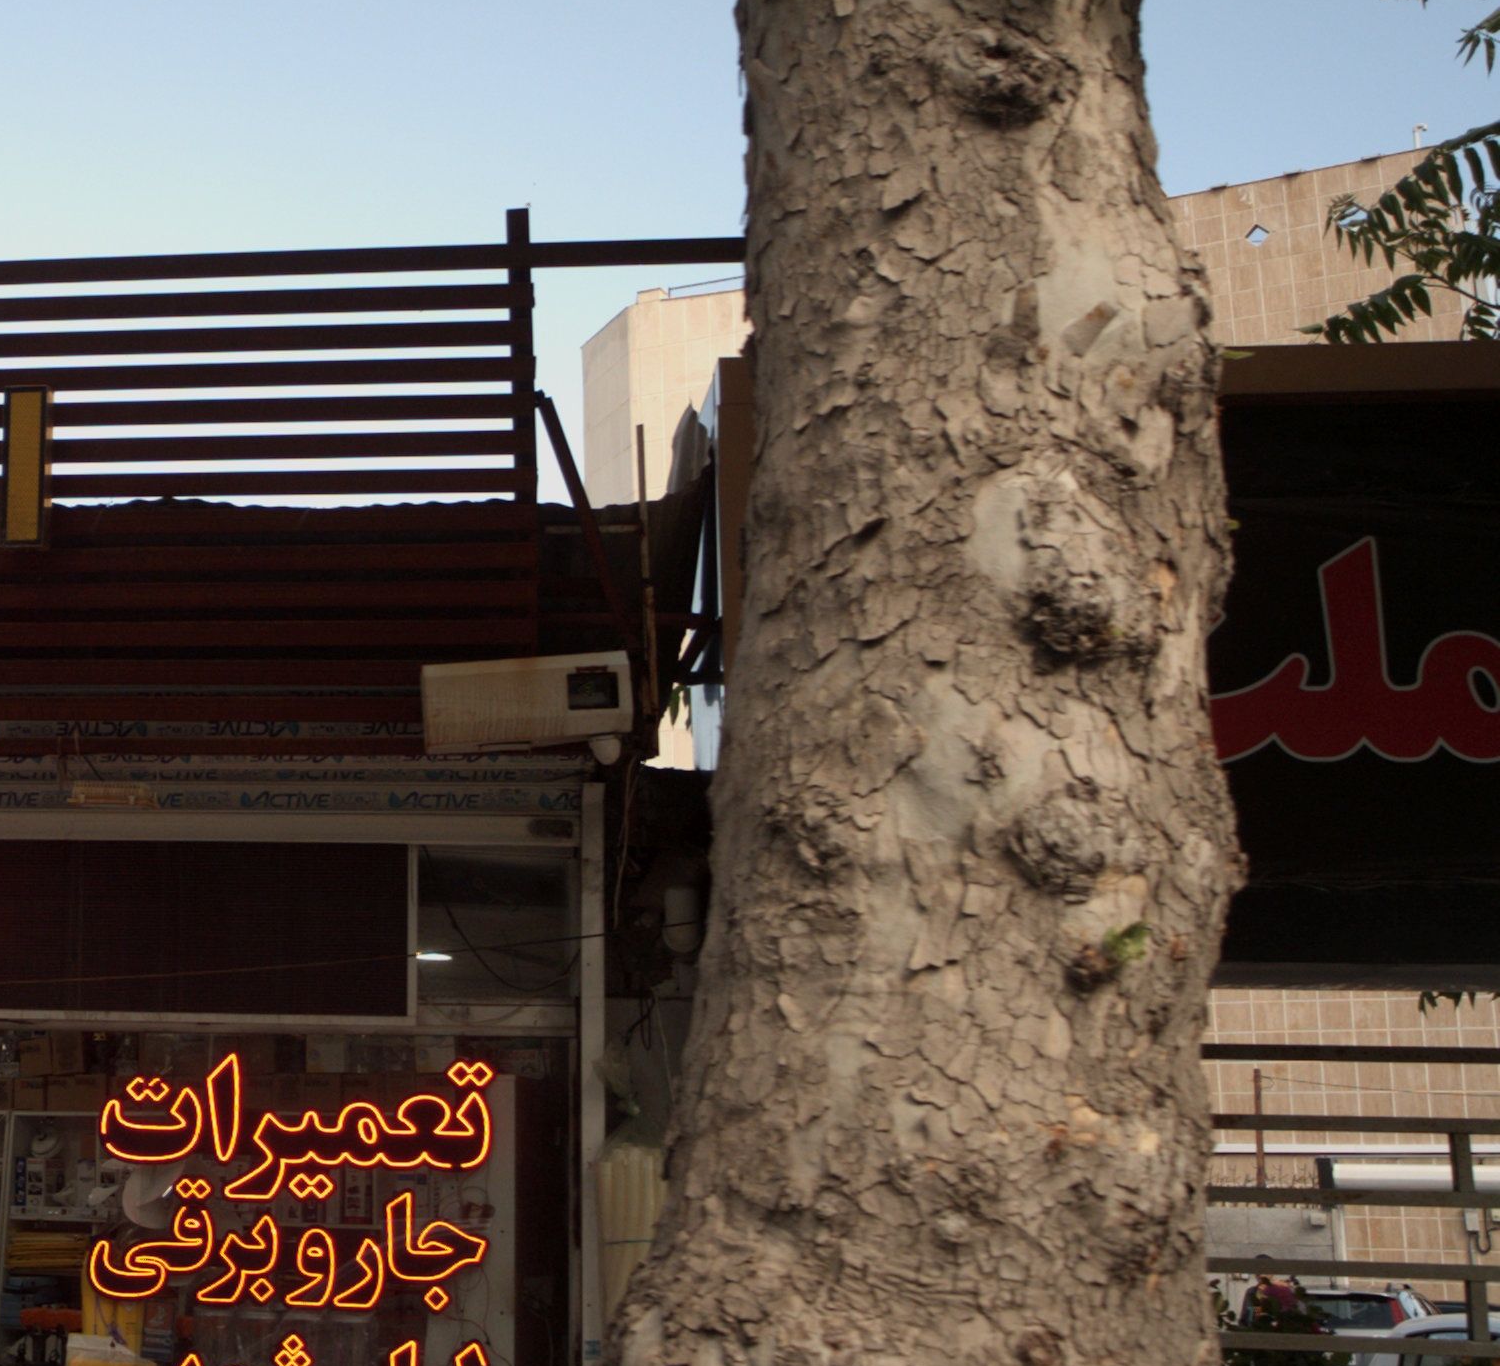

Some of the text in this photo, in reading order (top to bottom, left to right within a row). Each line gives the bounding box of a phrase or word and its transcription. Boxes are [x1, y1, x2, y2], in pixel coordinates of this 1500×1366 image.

[250, 791, 330, 809] ACTIVE
[398, 791, 479, 810] ACTIVE
[100, 1052, 494, 1200] تعمیرات
[90, 1177, 279, 1304] برقی
[285, 1192, 488, 1312] جارو
